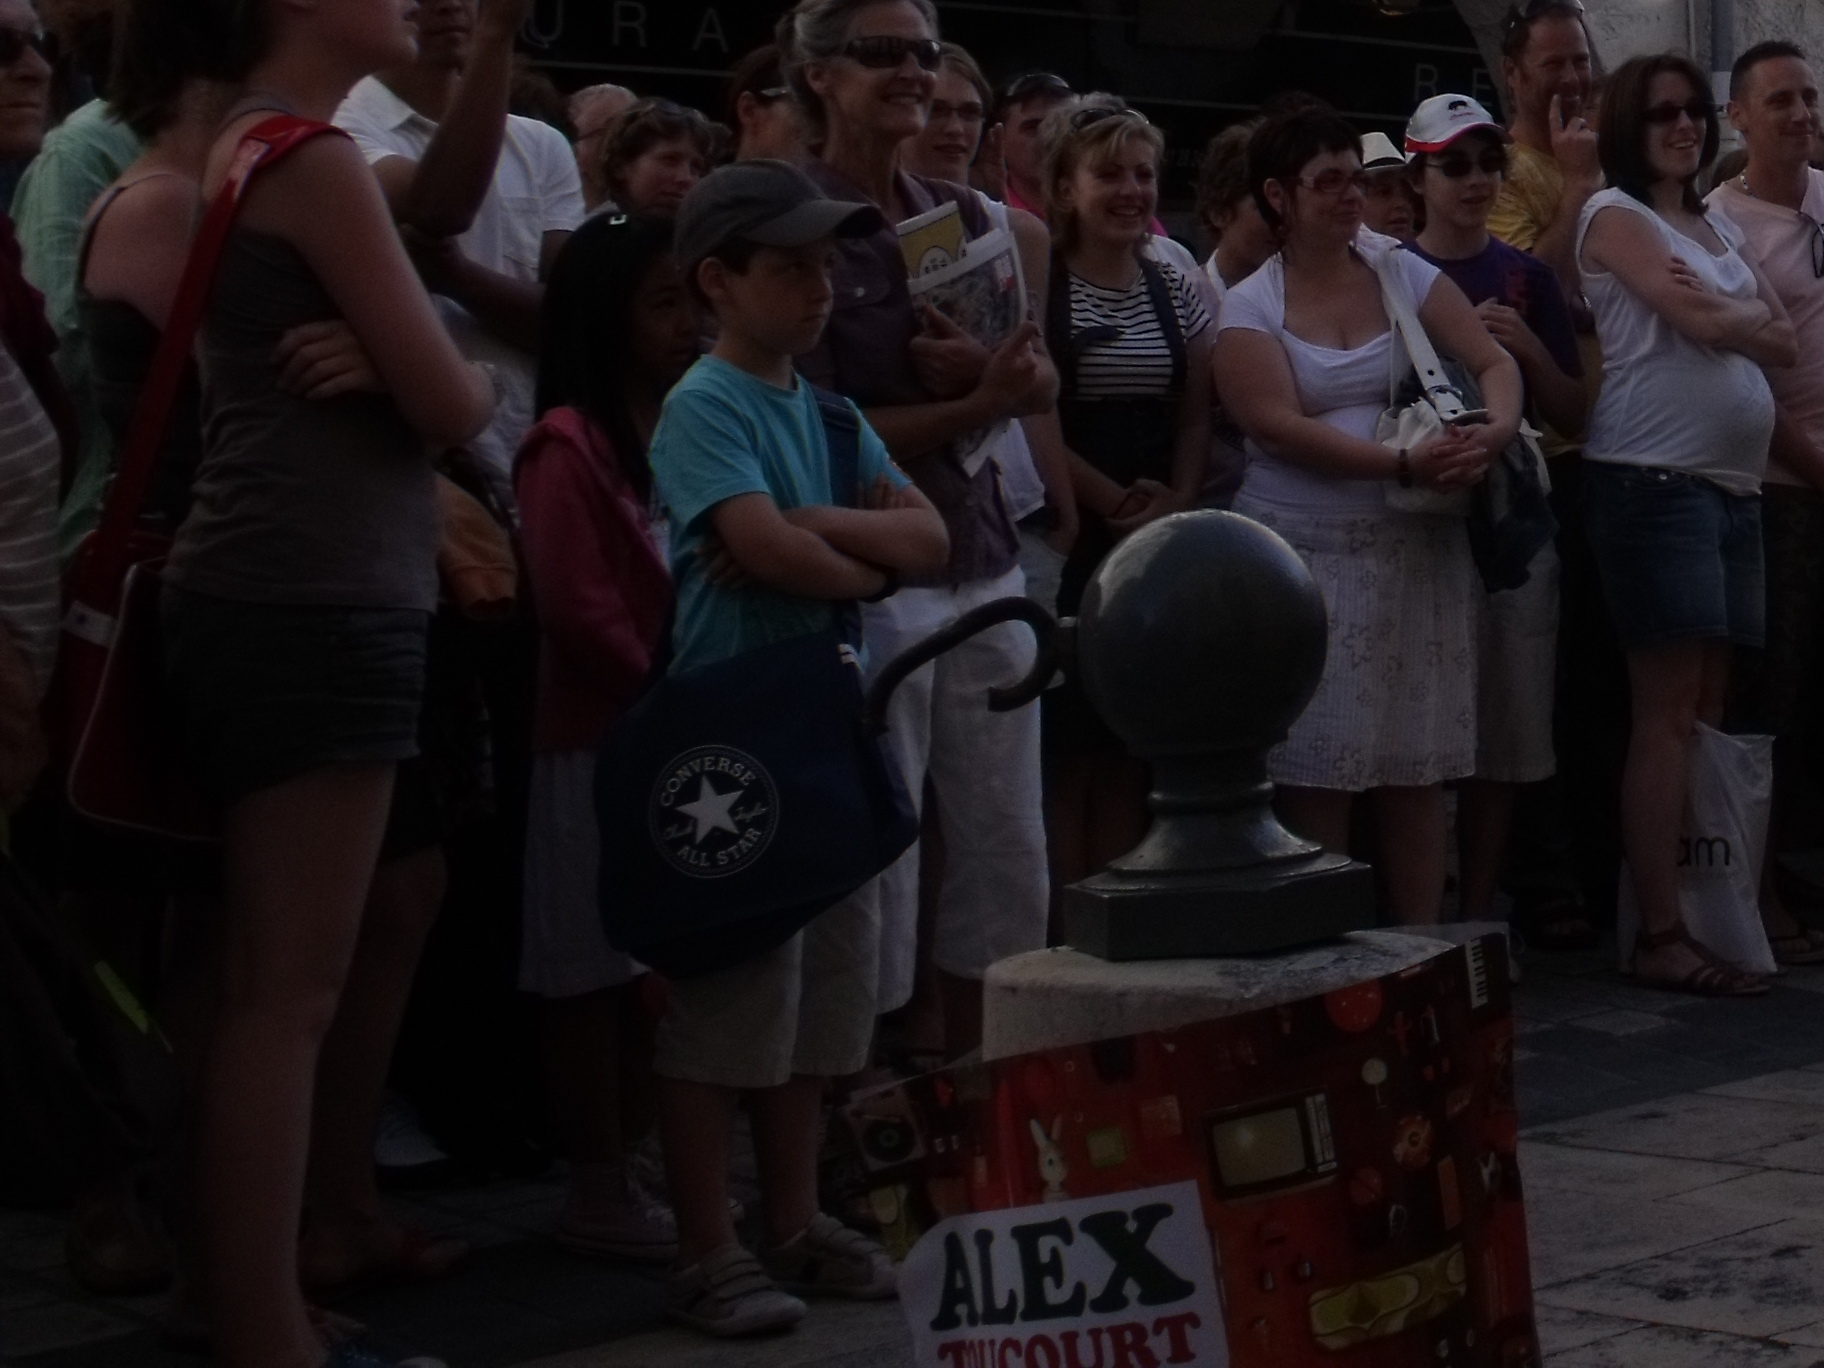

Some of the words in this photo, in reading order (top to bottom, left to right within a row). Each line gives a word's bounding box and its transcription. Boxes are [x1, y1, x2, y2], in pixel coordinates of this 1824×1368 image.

[660, 756, 757, 807] CONVERSE
[677, 844, 710, 867] ALL
[716, 827, 762, 865] STAR
[929, 1203, 1196, 1331] ALEX
